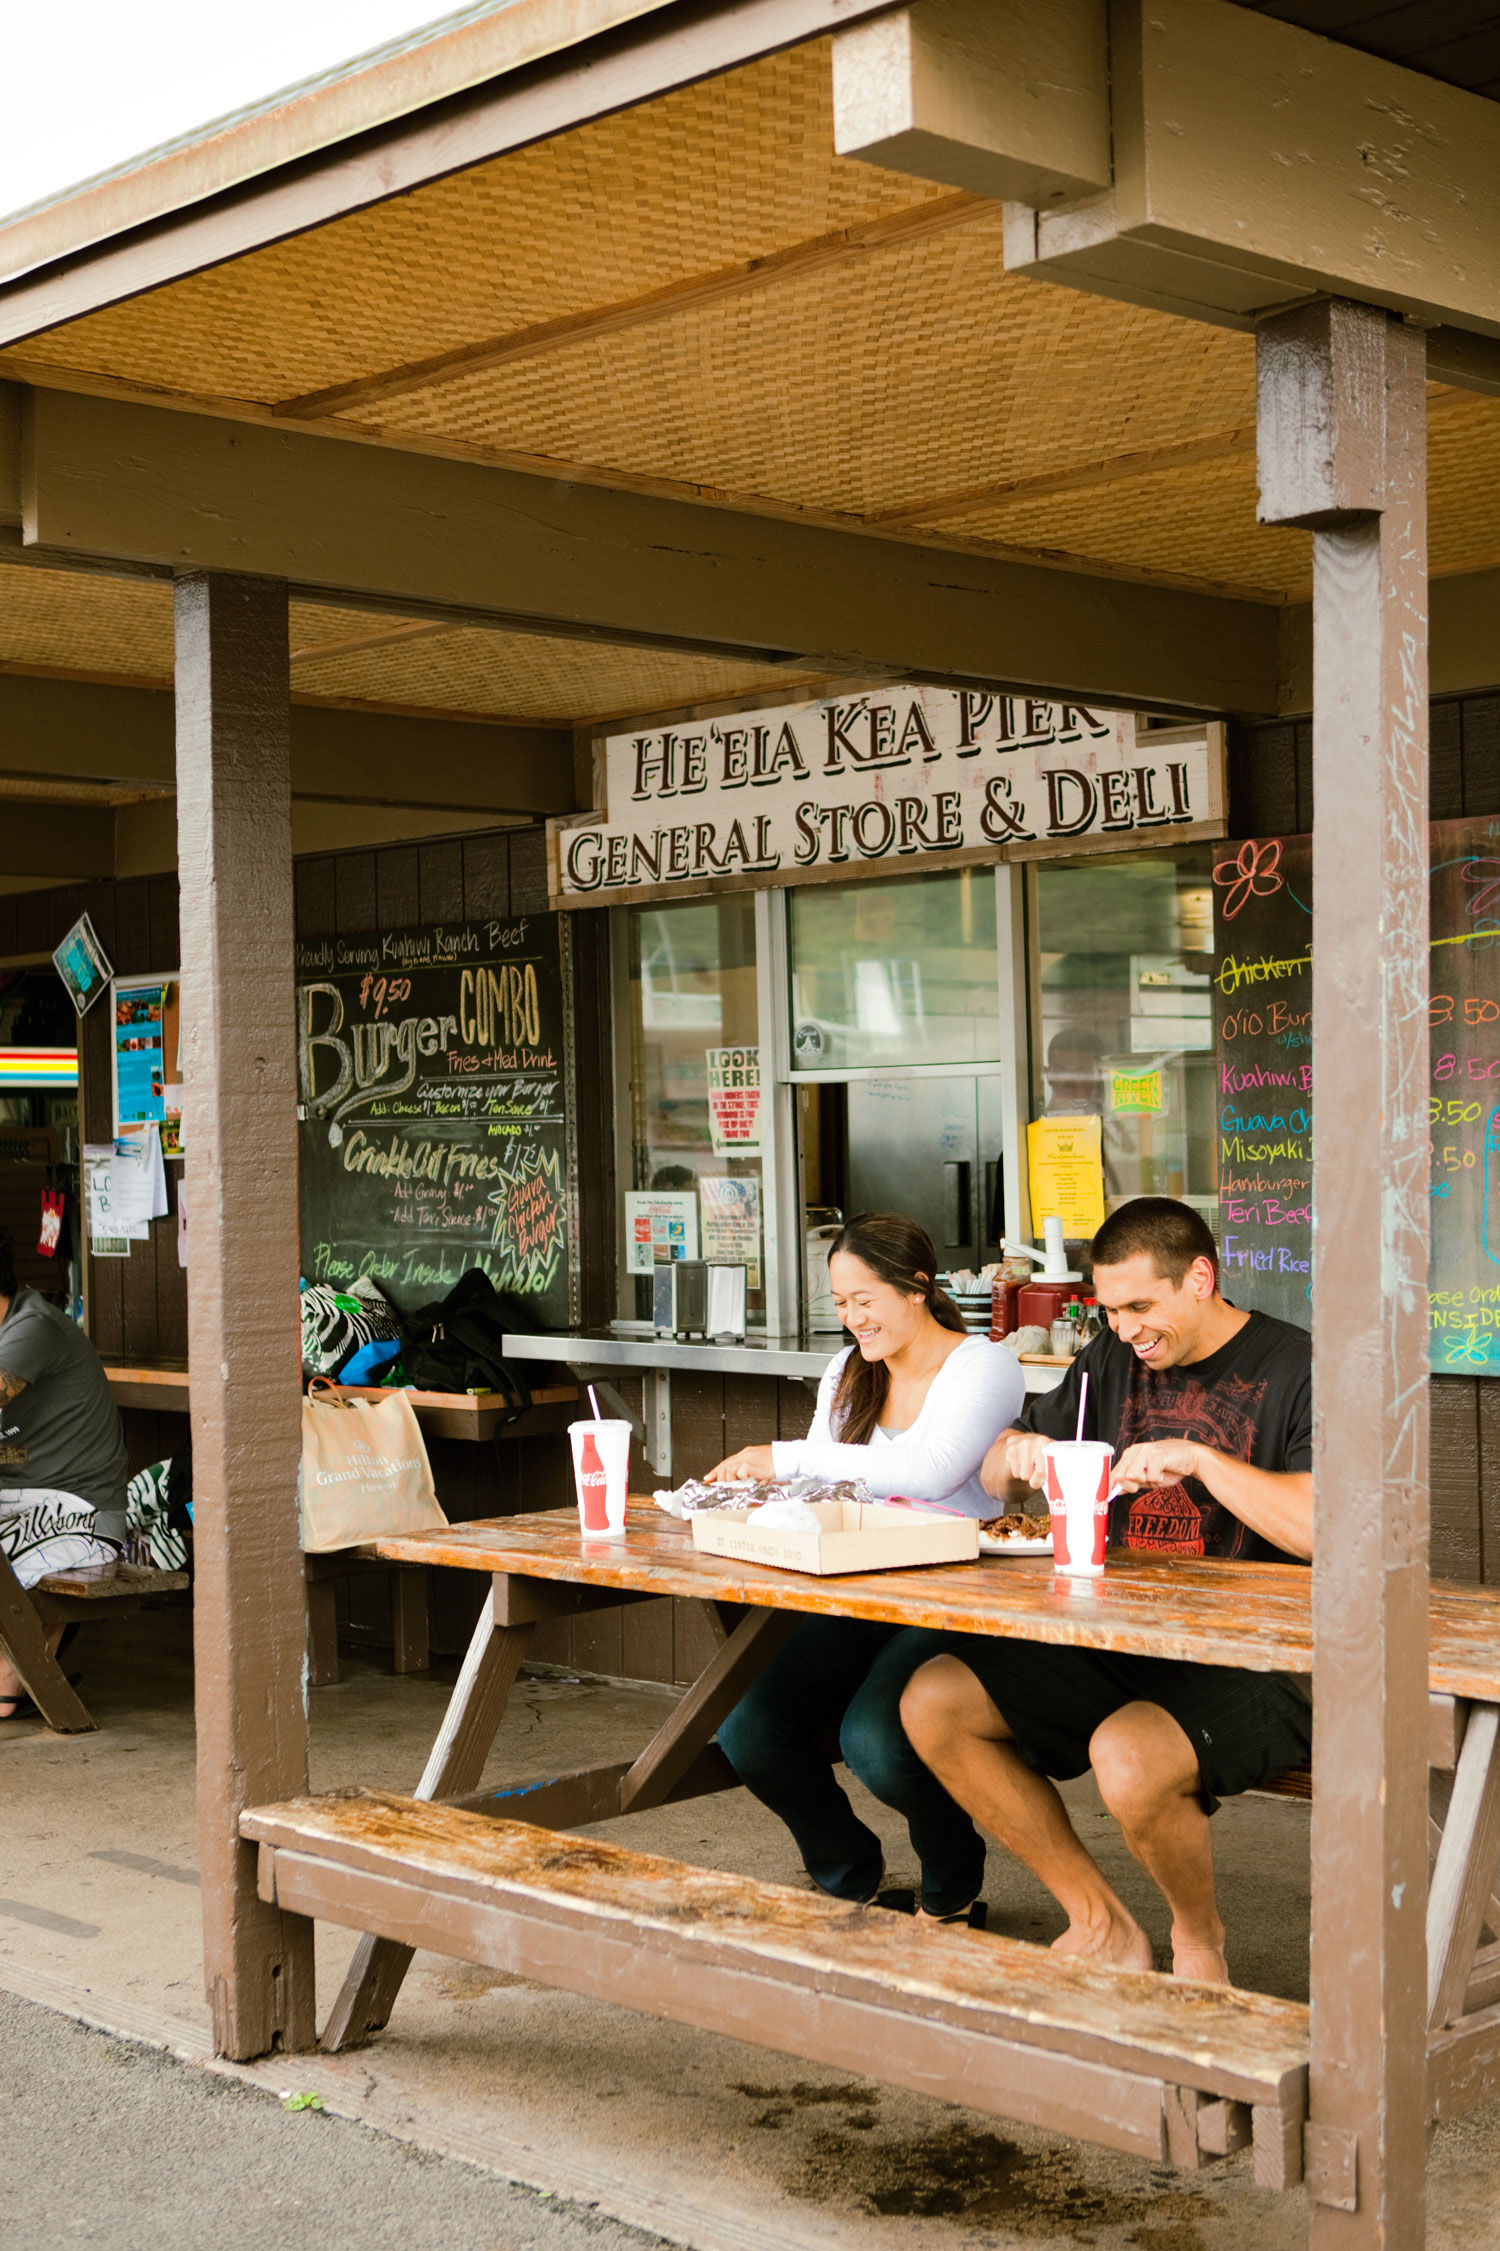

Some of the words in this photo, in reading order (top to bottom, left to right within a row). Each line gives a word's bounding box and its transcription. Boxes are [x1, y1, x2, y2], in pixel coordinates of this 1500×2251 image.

[821, 697, 942, 776] KEA
[953, 688, 1110, 758] PIER
[567, 814, 779, 892] GENERAL
[793, 791, 964, 866] STORE
[980, 776, 1037, 844] &
[1042, 762, 1194, 838] DELI
[337, 939, 379, 971] Serving
[433, 926, 480, 954] Ranch
[484, 918, 530, 950] Beef
[1219, 954, 1302, 995] Chicken
[359, 972, 412, 1020] $9.50
[460, 962, 540, 1048] COMBO
[1266, 1000, 1313, 1037] Bur
[298, 982, 458, 1110] Burger
[447, 1050, 480, 1074] Fries
[522, 1047, 558, 1068] Drink
[709, 1049, 760, 1069] LOOK
[416, 1082, 483, 1100] Customize
[484, 1083, 511, 1105] your
[709, 1069, 760, 1088] HERE!
[1112, 1075, 1159, 1093] GREEN
[1222, 1062, 1297, 1095] Kuahiwi
[392, 1101, 423, 1115] Cheese
[1114, 1091, 1160, 1106] RIVER
[487, 1123, 522, 1136] AVOCADO
[1220, 1104, 1287, 1133] Guava
[344, 1129, 412, 1180] Crinkle
[411, 1141, 446, 1184] Cut
[443, 1141, 501, 1187] Fries
[1221, 1135, 1303, 1165] Misoyaki
[508, 1175, 547, 1213] Guava
[1219, 1167, 1310, 1204] Hamburger
[393, 1205, 414, 1223] Add
[1220, 1199, 1261, 1225] Teri
[518, 1203, 558, 1256] Burger
[313, 1243, 355, 1280] Please
[357, 1250, 400, 1281] Order
[1221, 1235, 1274, 1268] Fried
[1277, 1247, 1310, 1273] Rice
[1429, 1307, 1500, 1329] NSIDE
[316, 1466, 361, 1486] Grand
[360, 1457, 423, 1480] Vacations
[346, 1453, 388, 1467] Hilton
[1128, 1514, 1202, 1539] FREEDOM
